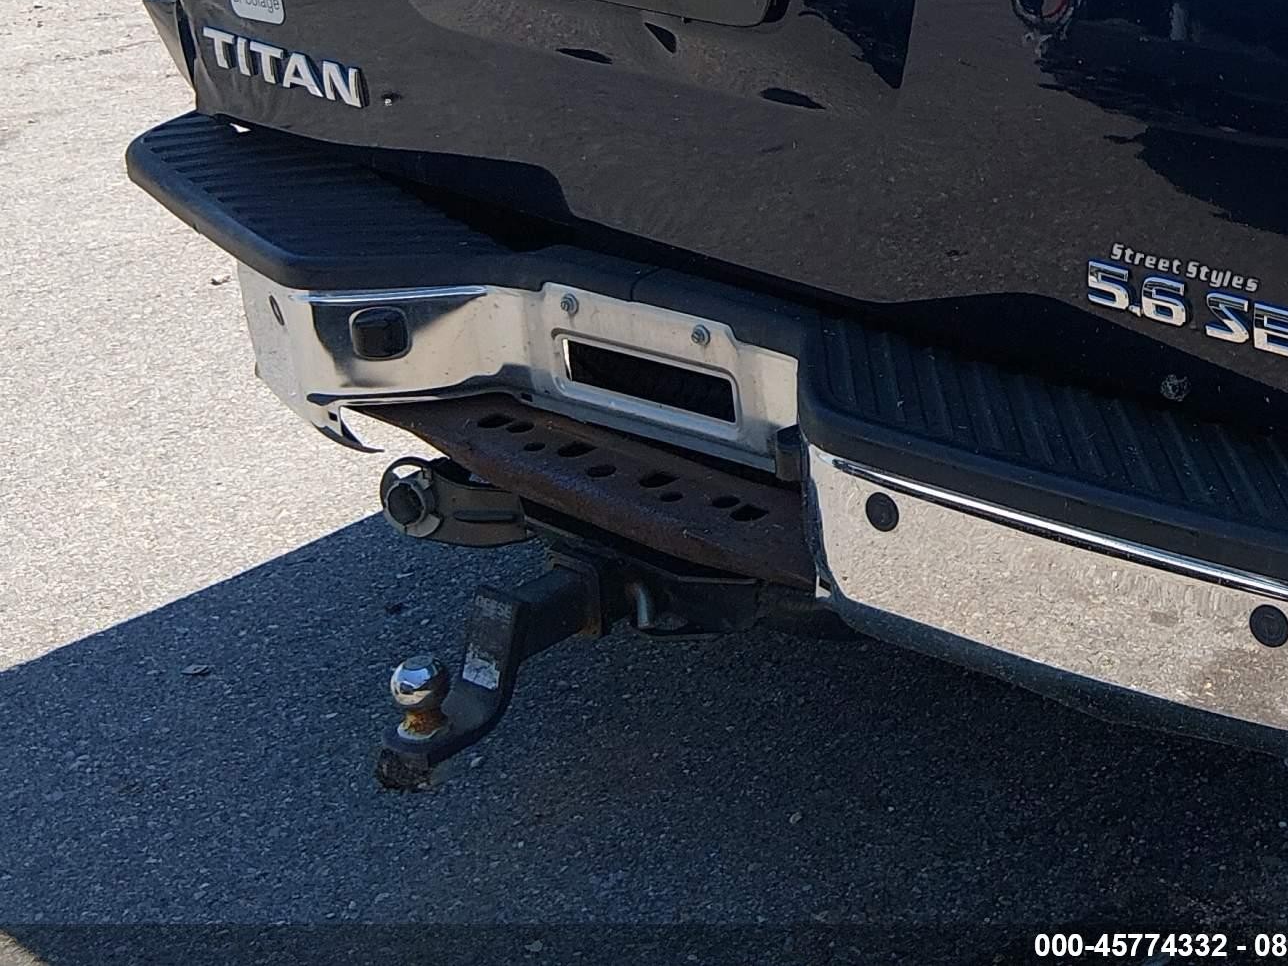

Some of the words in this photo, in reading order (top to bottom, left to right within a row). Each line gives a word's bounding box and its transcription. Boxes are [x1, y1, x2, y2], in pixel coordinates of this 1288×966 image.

[203, 26, 364, 108] TITAN
[1088, 260, 1187, 326] 5.6
[1111, 242, 1181, 274] Street
[1186, 260, 1260, 292] Styles
